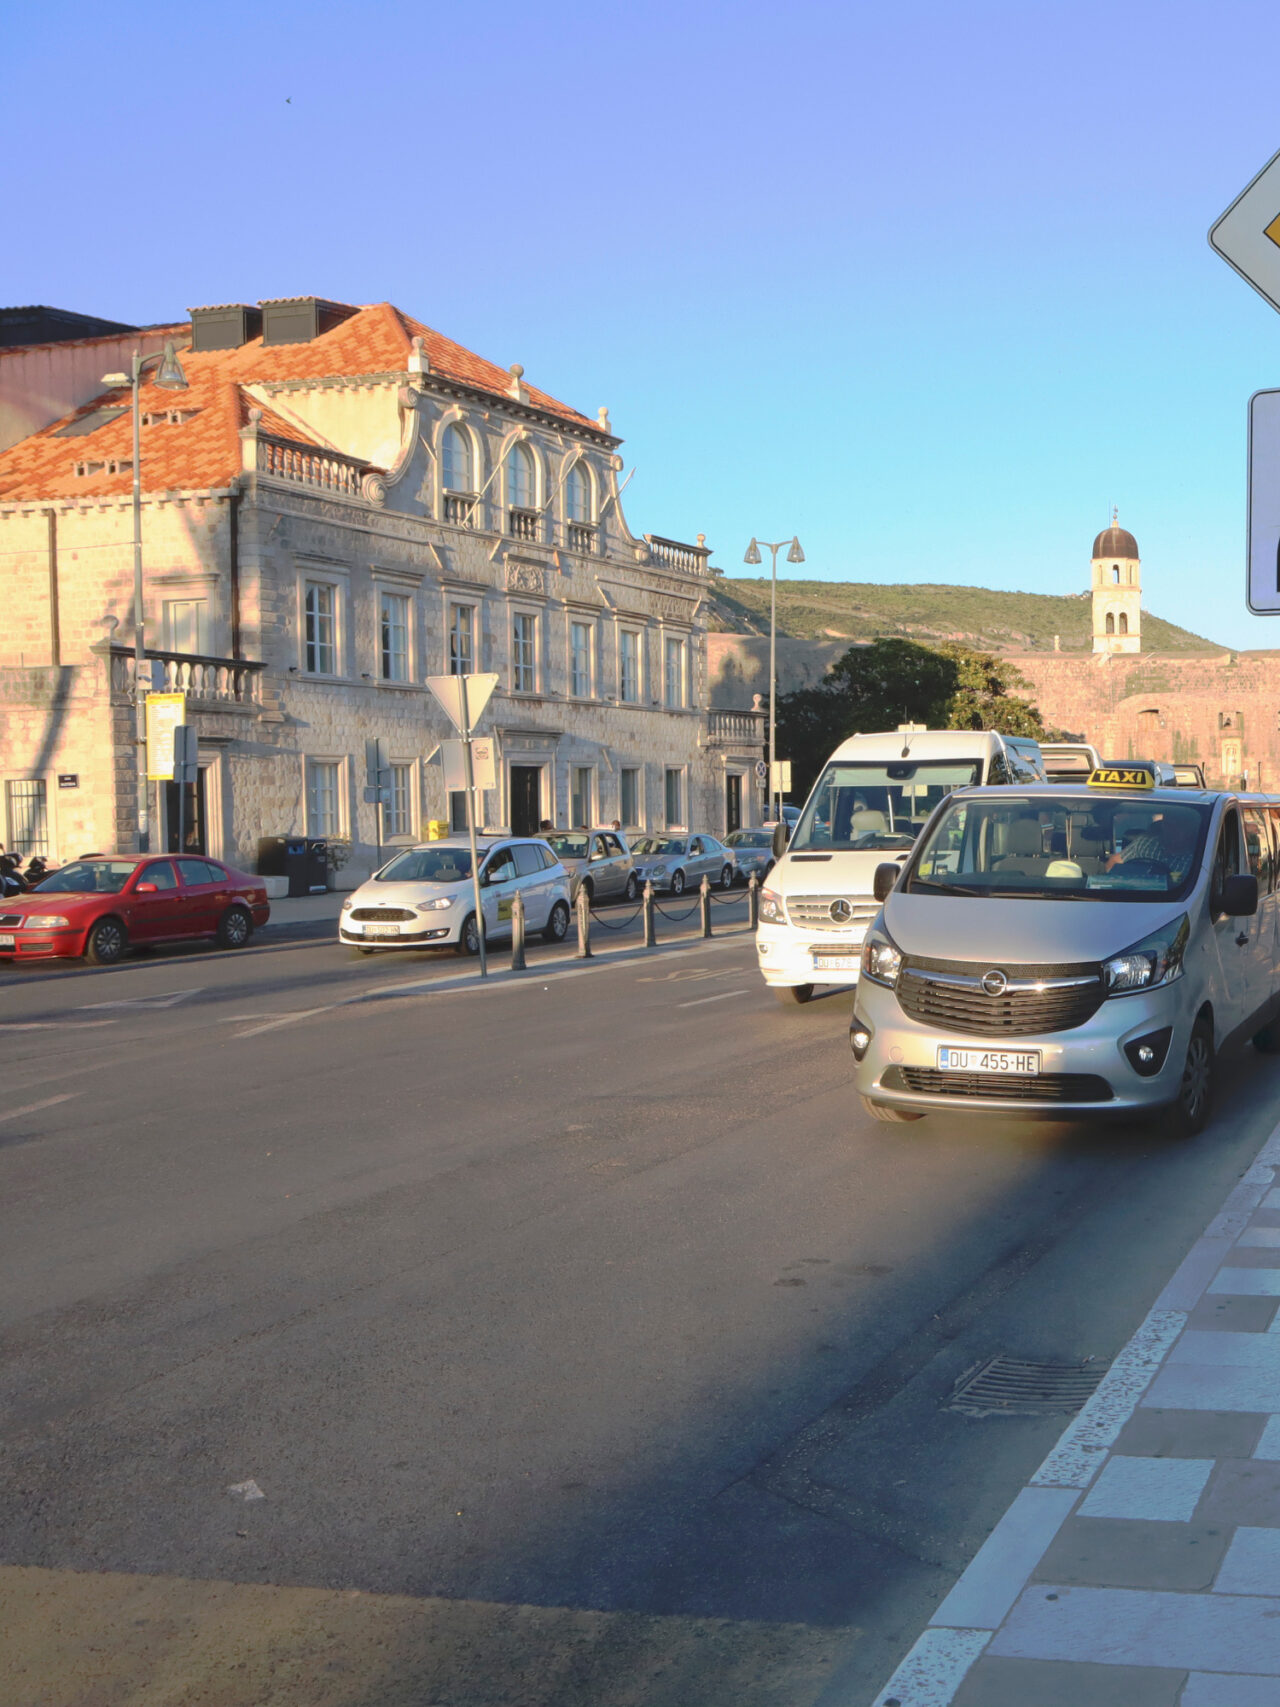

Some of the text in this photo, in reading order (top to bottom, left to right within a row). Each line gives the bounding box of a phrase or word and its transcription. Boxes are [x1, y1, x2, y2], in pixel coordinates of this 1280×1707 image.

[1096, 770, 1143, 784] TAXI
[950, 1051, 1036, 1072] DU 455-HE
